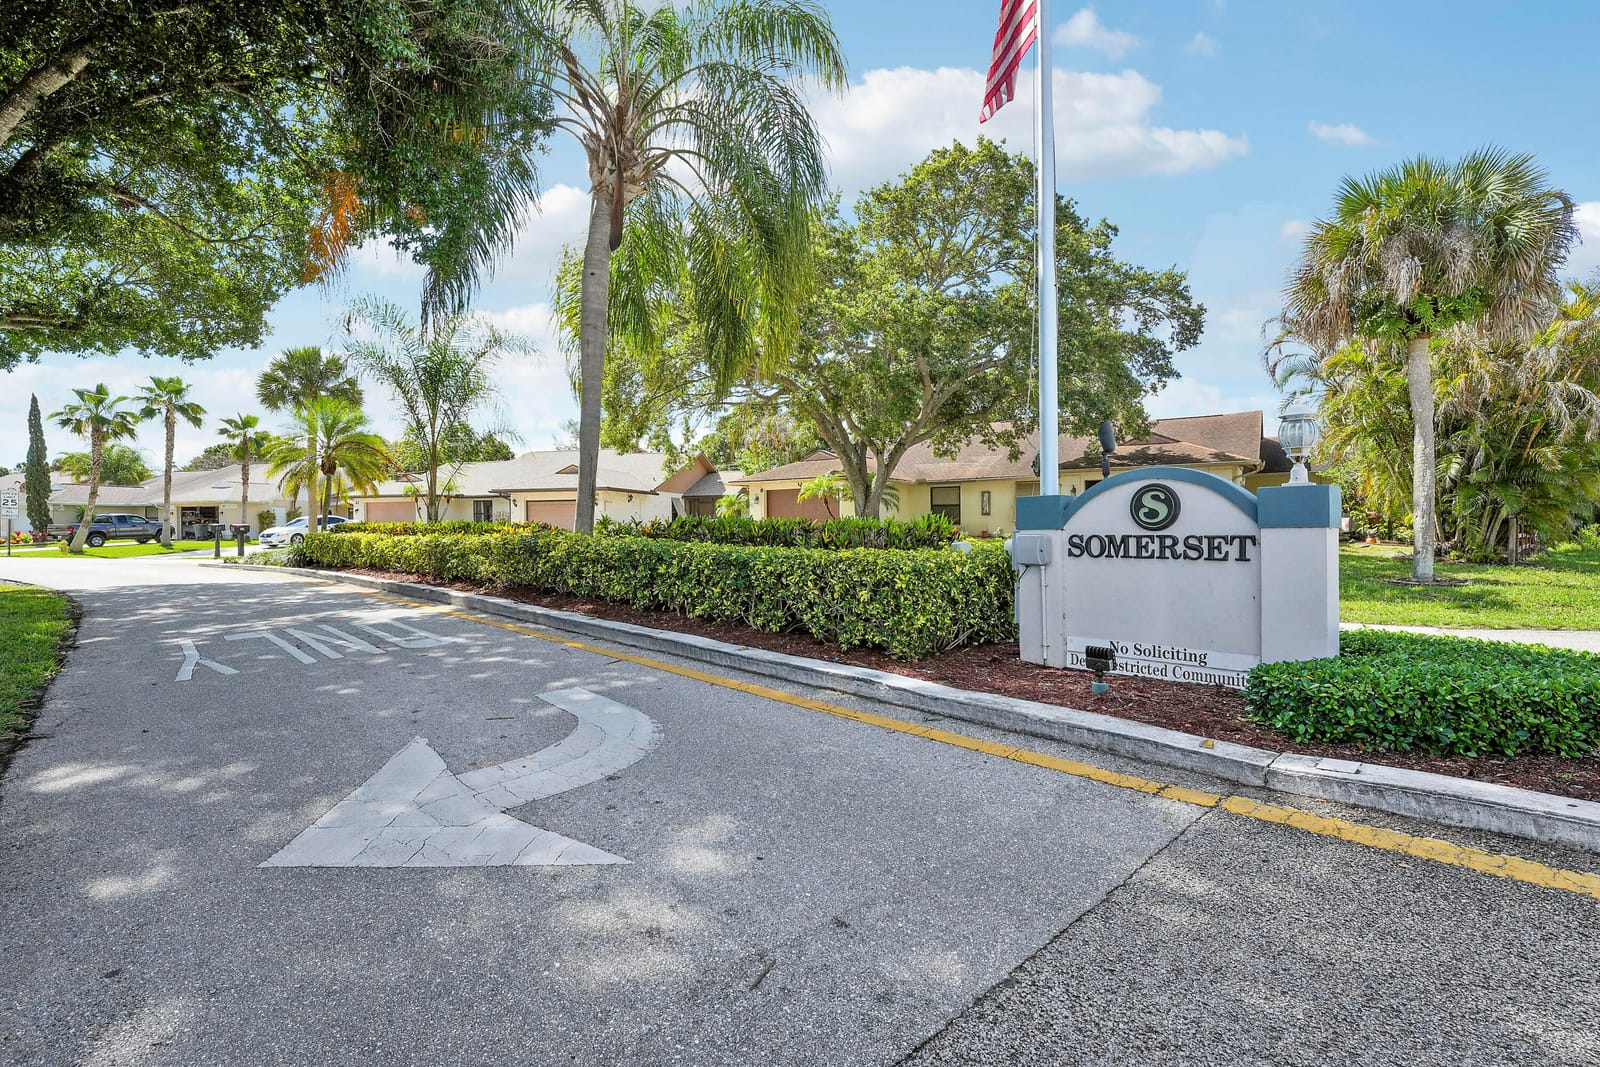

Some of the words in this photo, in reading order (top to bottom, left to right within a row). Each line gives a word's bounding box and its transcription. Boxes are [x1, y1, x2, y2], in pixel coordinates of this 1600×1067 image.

[1138, 490, 1169, 523] S
[1068, 534, 1257, 562] SOMERSET
[174, 617, 452, 682] ONLY
[1109, 640, 1129, 655] No
[1133, 643, 1208, 667] Soliciting
[1111, 660, 1168, 678] estricted
[1173, 665, 1247, 688] Communit
